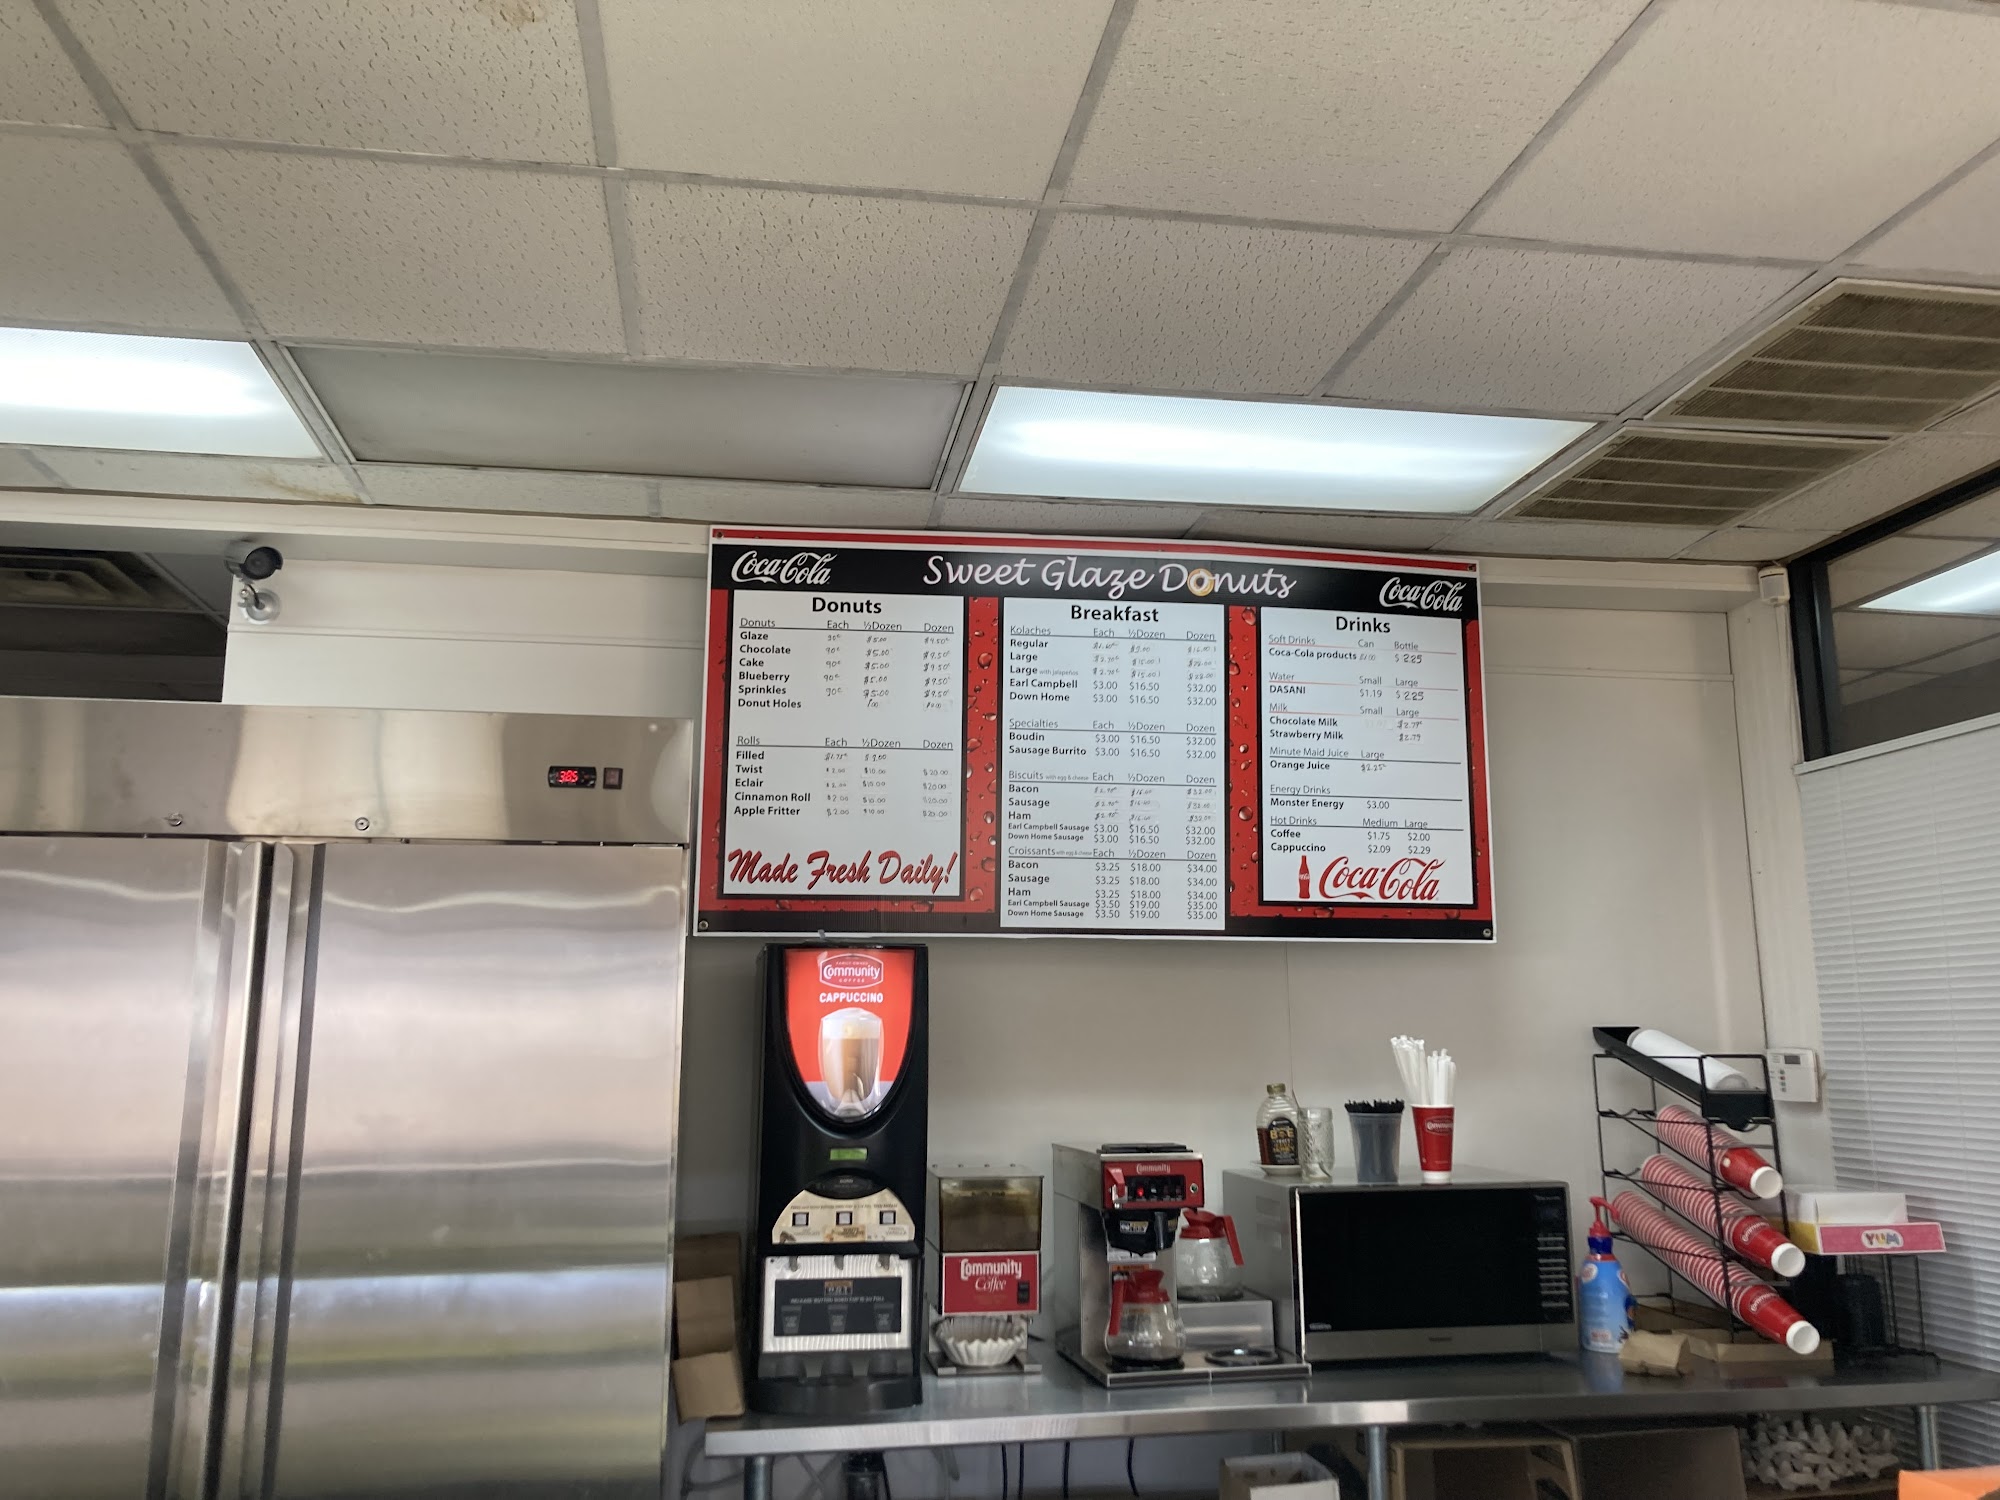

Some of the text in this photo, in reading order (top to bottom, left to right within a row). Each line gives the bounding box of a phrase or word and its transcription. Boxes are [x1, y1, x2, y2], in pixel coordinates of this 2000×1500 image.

[731, 550, 838, 585] Coca-Cola
[923, 555, 1297, 600] Sweet Glaze Donuts
[1379, 577, 1466, 612] Coca-Cola
[812, 597, 882, 615] Donuts
[1071, 605, 1159, 622] Breakfast
[740, 617, 954, 633] Donuts Each Dozen
[1336, 616, 1391, 633] Drinks
[740, 632, 769, 641] Glaze
[1010, 626, 1215, 641] Kolaches Each Dozen
[1010, 639, 1049, 650] Regular
[1269, 635, 1418, 650] Soft Drinks Can Bottle
[740, 645, 791, 654] Chocolate
[1269, 648, 1357, 661] Coca-Cola products
[740, 659, 764, 668] Cake
[1010, 653, 1038, 663] Large
[1010, 665, 1038, 676] Large
[739, 672, 790, 683] Blueberry
[1269, 672, 1418, 688] Water Small Large
[738, 685, 787, 695] Sprinkles
[1010, 679, 1217, 693] Earl Campbell $3.00 $16.50 $32.00
[1269, 685, 1382, 698] DASANI $1.19
[738, 699, 802, 709] Donut Holes
[1010, 692, 1217, 707] Down Home $3.00 $16.50 $32.00
[1269, 703, 1419, 718] Milk Small Large
[1009, 719, 1215, 733] Specialties Each Dozen
[1270, 717, 1338, 727] Chocolate Milk
[1009, 732, 1216, 747] Boudin $3.00 $16.50 $32.00
[1270, 729, 1344, 740] Strawberry Milk
[737, 736, 953, 749] Rolls Each Dozen
[736, 751, 765, 760] Filled
[1009, 746, 1216, 760] Sausage Burrito $3.00 $16.50 $32.00
[1270, 747, 1385, 760] Minute Maid Juice Large
[736, 765, 763, 774] Twist
[1270, 761, 1330, 771] Orange Juice
[735, 778, 763, 787] Eclair
[1009, 771, 1215, 784] Biscuits Each Dozen
[1009, 785, 1039, 793] Bacon
[1270, 784, 1330, 795] Energy Drinks
[735, 792, 811, 802] Cinnamon Roll
[1009, 798, 1050, 808] Sausage
[1270, 799, 1390, 810] Monster Energy $3.00
[734, 806, 800, 817] Apple Fritter
[1009, 811, 1031, 820] Ham
[1270, 816, 1398, 828] Hot Drinks Medium
[1024, 824, 1058, 832] Campbell
[1060, 824, 1089, 832] Sausage
[1094, 824, 1119, 834] $3.00
[1129, 825, 1160, 835] $16.50
[1185, 826, 1215, 836] $32.00
[1271, 830, 1431, 842] Coffee $1.75 $2.00
[1054, 834, 1084, 842] Sausage
[1094, 835, 1119, 844] $3.00
[1129, 835, 1160, 845] $16.50
[1185, 836, 1216, 846] $32.00
[1008, 846, 1216, 860] Croissants Each Dozen
[1271, 843, 1431, 855] Cappuccino $2.09 $2.29
[728, 849, 958, 895] Made Fresh Daily!
[1008, 861, 1217, 874] Bacon $3.25 $18.00 $34.00
[1008, 874, 1217, 887] Sausage $3.25 $18.00 $34.00
[1319, 856, 1447, 901] Coca-Cola
[1008, 888, 1217, 901] Ham $3.25 $18.00 $34.00
[1024, 900, 1058, 908] Campbell
[1095, 900, 1120, 910] $3.50
[1129, 900, 1160, 910] $19.00
[1187, 901, 1217, 910] $35.00
[1095, 909, 1120, 919] $3.50
[1129, 910, 1160, 920] $19.00
[1187, 911, 1217, 921] $35.00
[824, 964, 880, 980] Community
[819, 992, 883, 1003] CAPPUCCINO
[1136, 1163, 1171, 1173] Community
[1865, 1232, 1900, 1247] YUM
[960, 1259, 1022, 1280] Community
[975, 1275, 1007, 1291] Coffee
